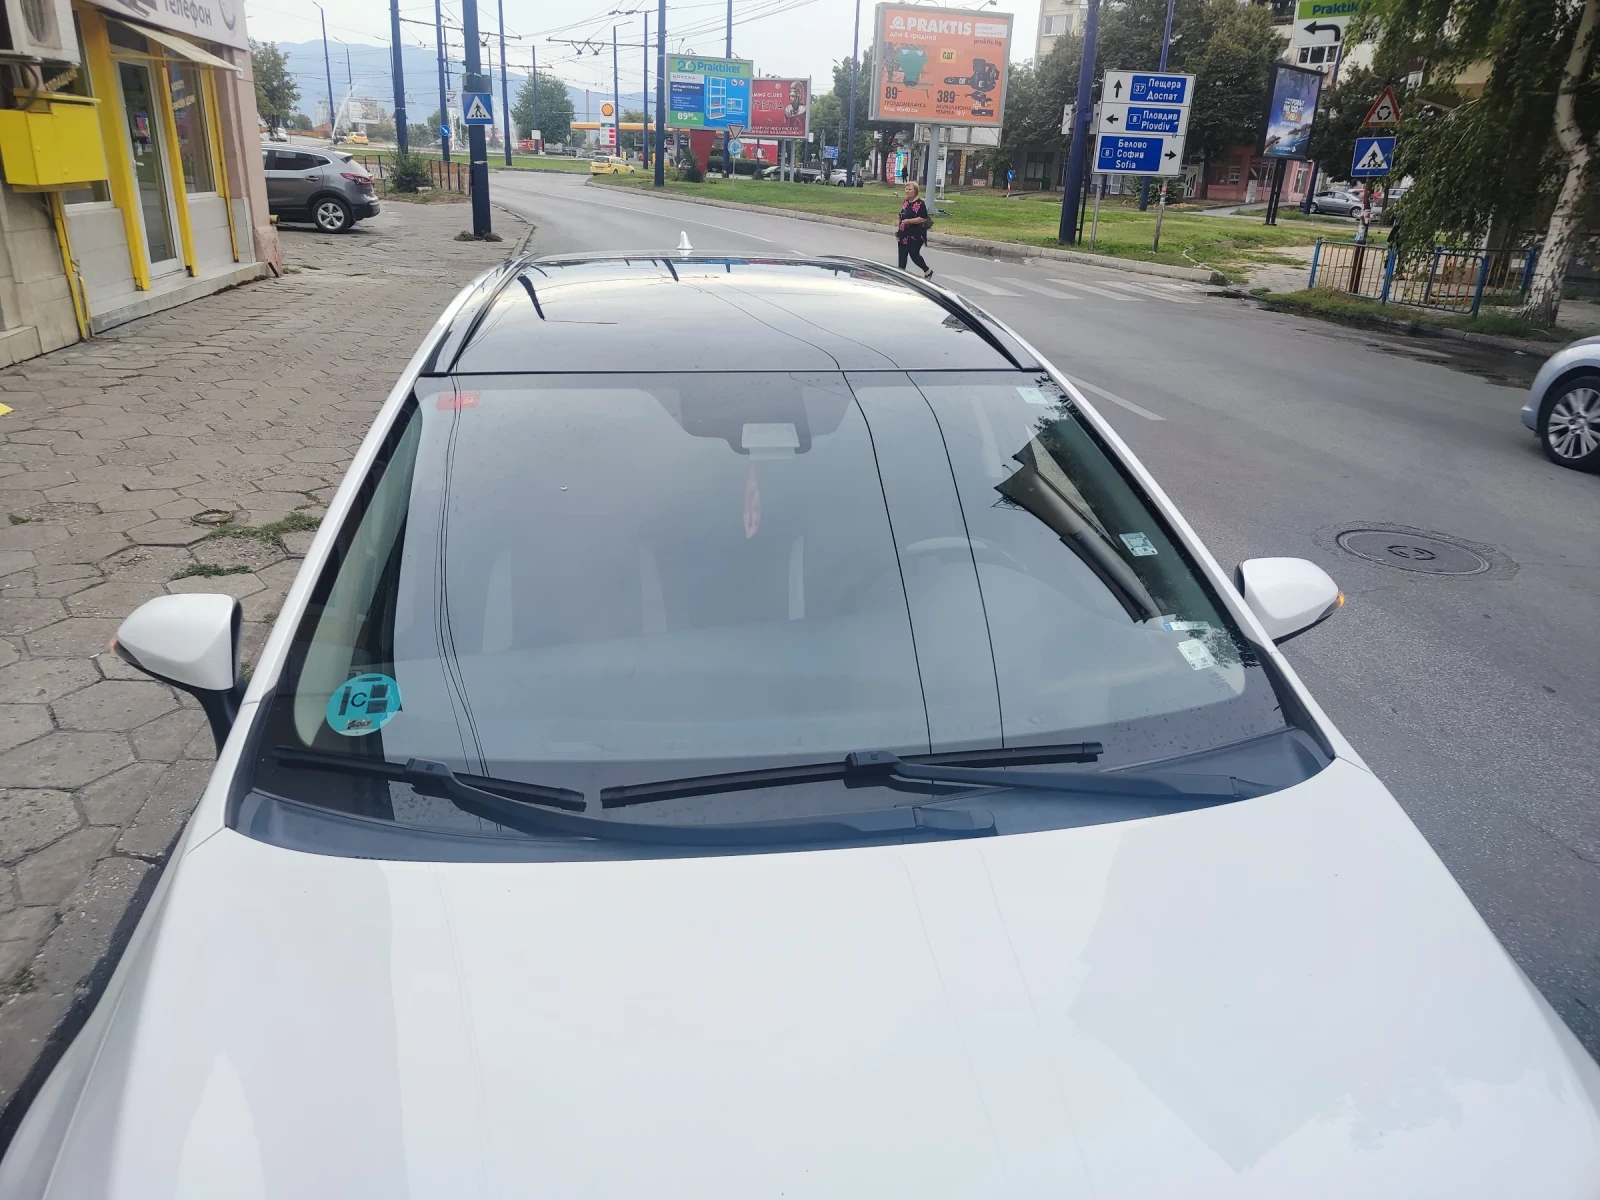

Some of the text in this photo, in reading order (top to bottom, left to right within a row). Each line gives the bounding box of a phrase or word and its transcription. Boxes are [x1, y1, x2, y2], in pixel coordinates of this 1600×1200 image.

[1312, 1, 1359, 16] Praktik
[907, 17, 973, 36] PRAKTIS
[910, 33, 937, 41] градина
[973, 38, 1003, 47] praktis.bg
[942, 51, 954, 60] CAT
[677, 60, 741, 74] 20 Praktiker
[1148, 78, 1182, 89] Пещера
[885, 86, 898, 99] 89
[936, 90, 956, 103] 389
[1146, 91, 1178, 101] Доспат
[677, 112, 688, 120] 89
[1142, 110, 1178, 120] Пловдив
[1141, 121, 1170, 131] Plovdiv
[1118, 138, 1147, 149] Белово
[1116, 149, 1145, 159] София
[1115, 159, 1136, 169] Sofia
[350, 692, 368, 708] C
